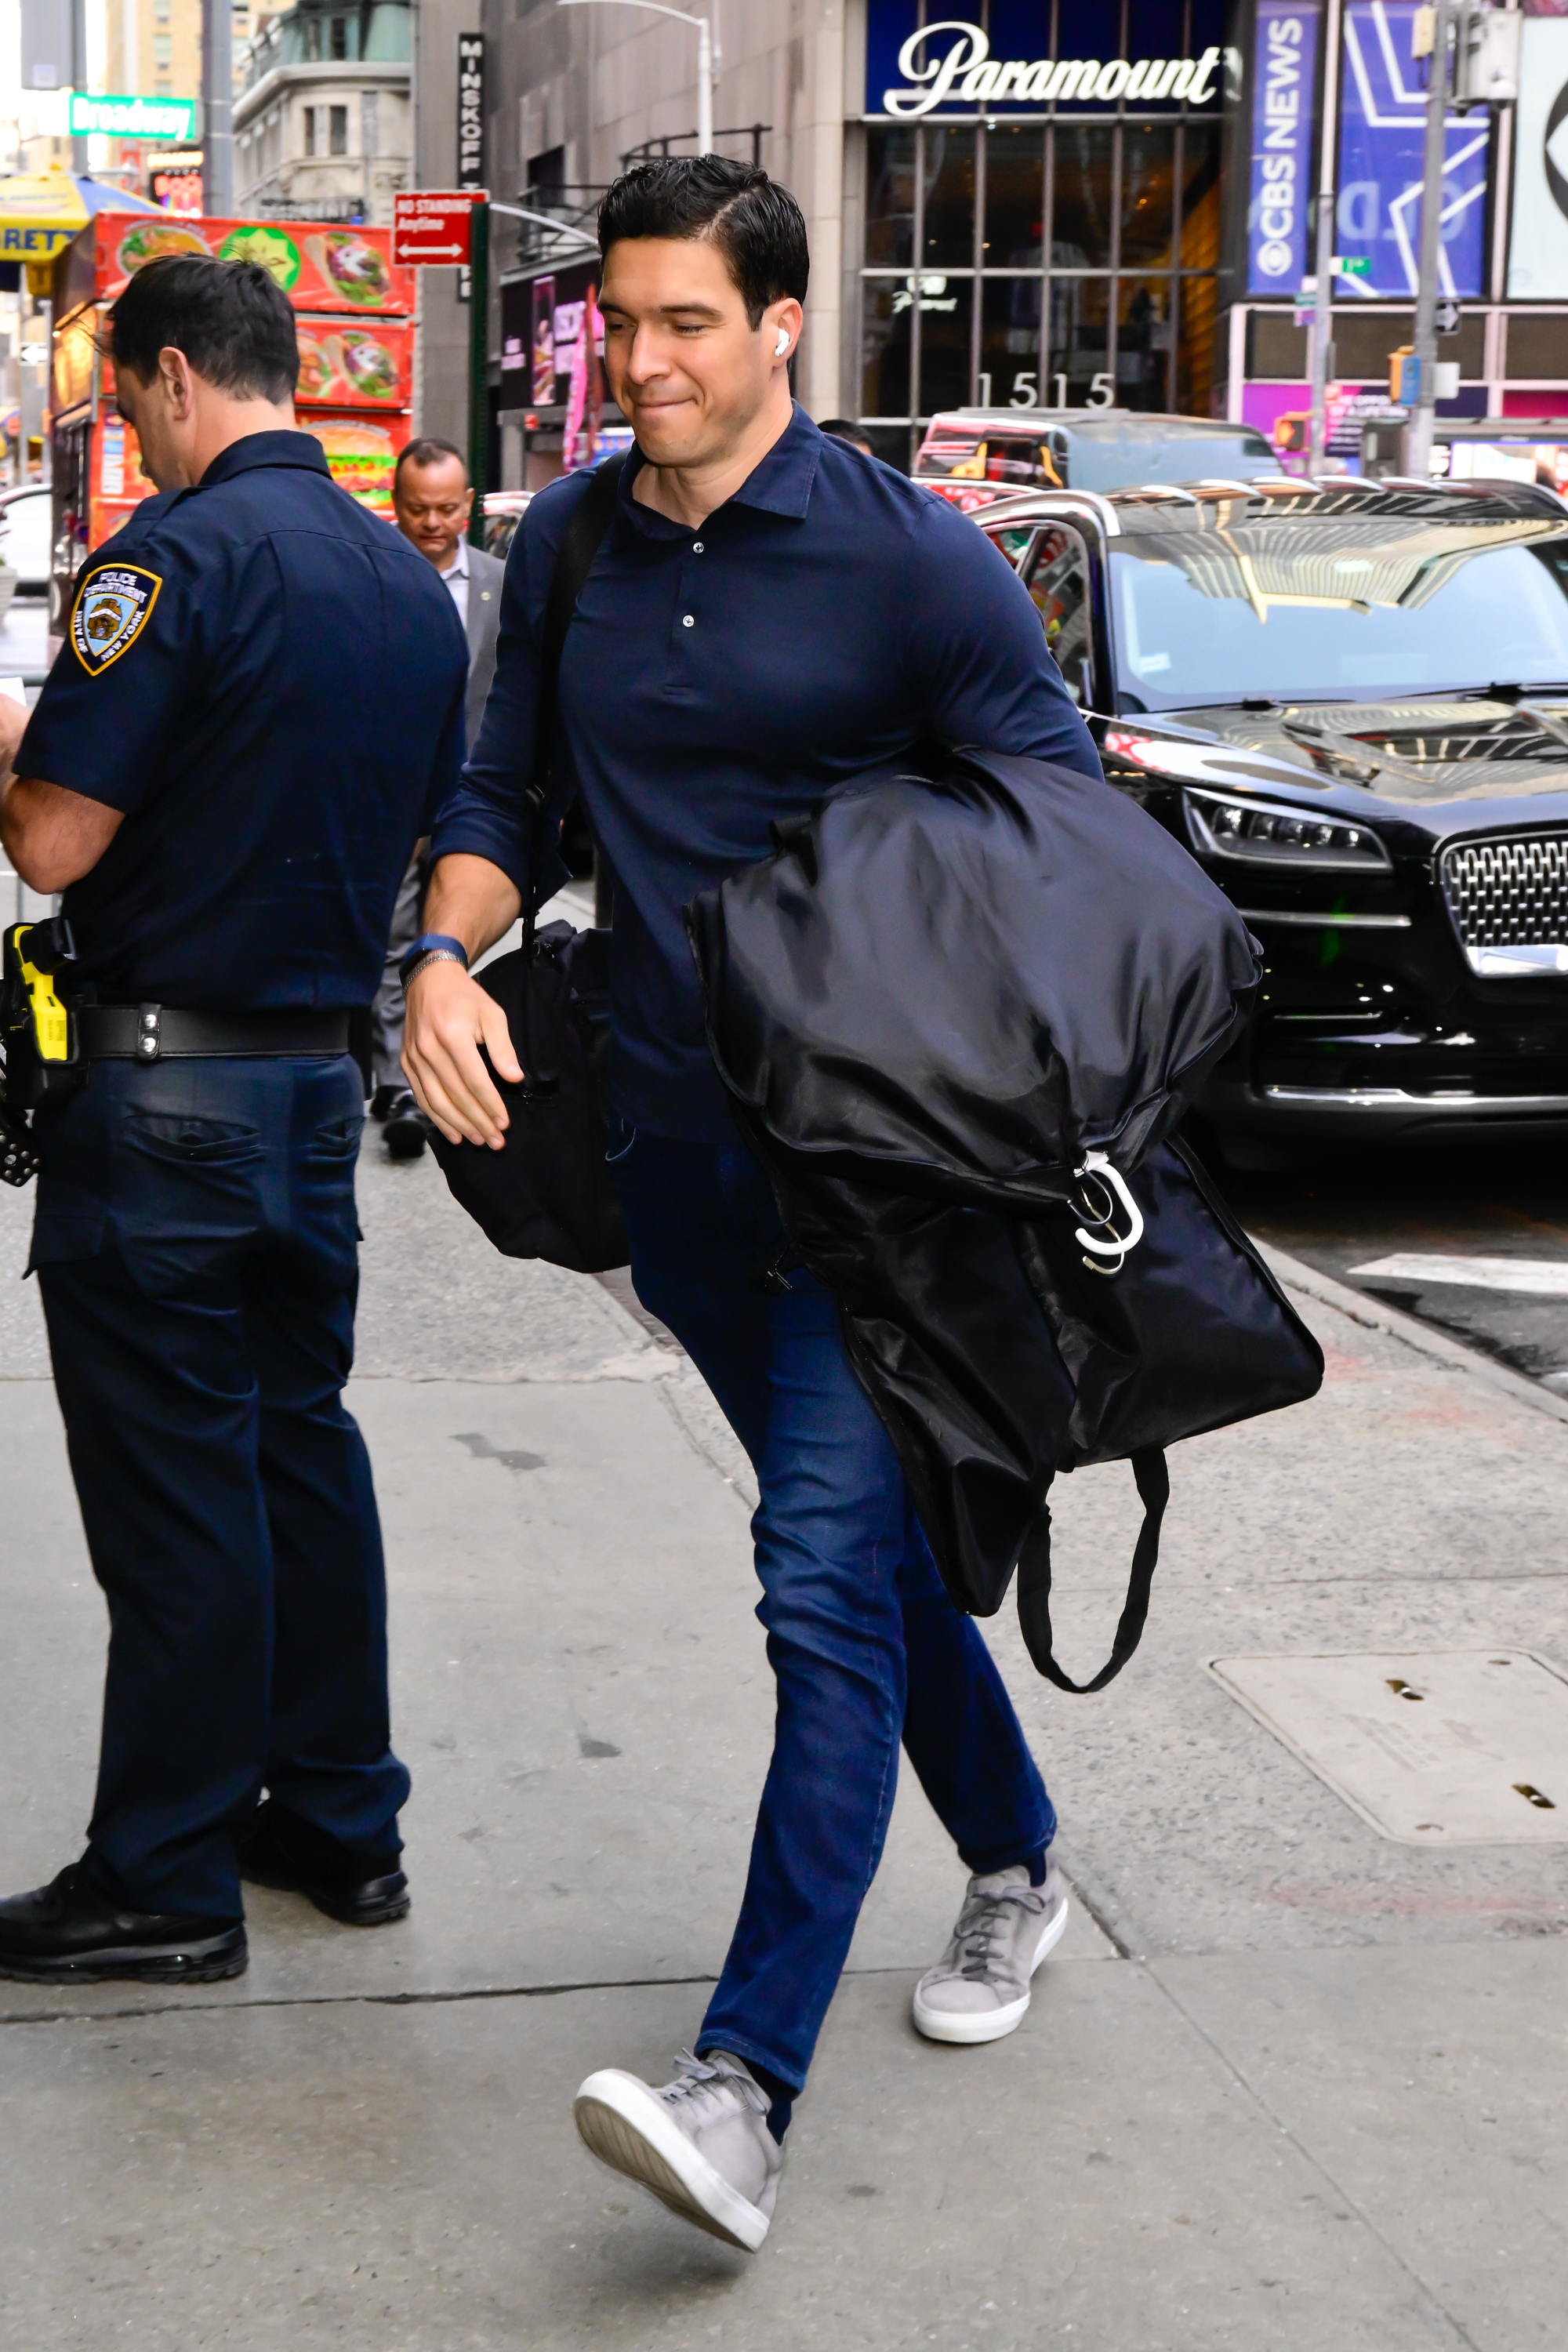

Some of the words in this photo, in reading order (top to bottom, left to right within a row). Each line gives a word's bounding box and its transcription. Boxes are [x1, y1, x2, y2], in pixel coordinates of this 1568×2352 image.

[883, 21, 1221, 116] Paramount
[1263, 18, 1303, 148] NEWS
[74, 97, 191, 141] Broadway
[461, 41, 482, 173] MINSKOFF
[397, 199, 415, 213] NO
[416, 198, 472, 213] STANDING
[1260, 154, 1296, 239] CBS
[398, 216, 445, 234] Anytime
[979, 372, 1115, 409] 1515
[84, 583, 147, 603] DEPARTMENT
[99, 572, 137, 586] POLICE
[100, 641, 122, 661] NEW
[120, 611, 146, 641] YORK
